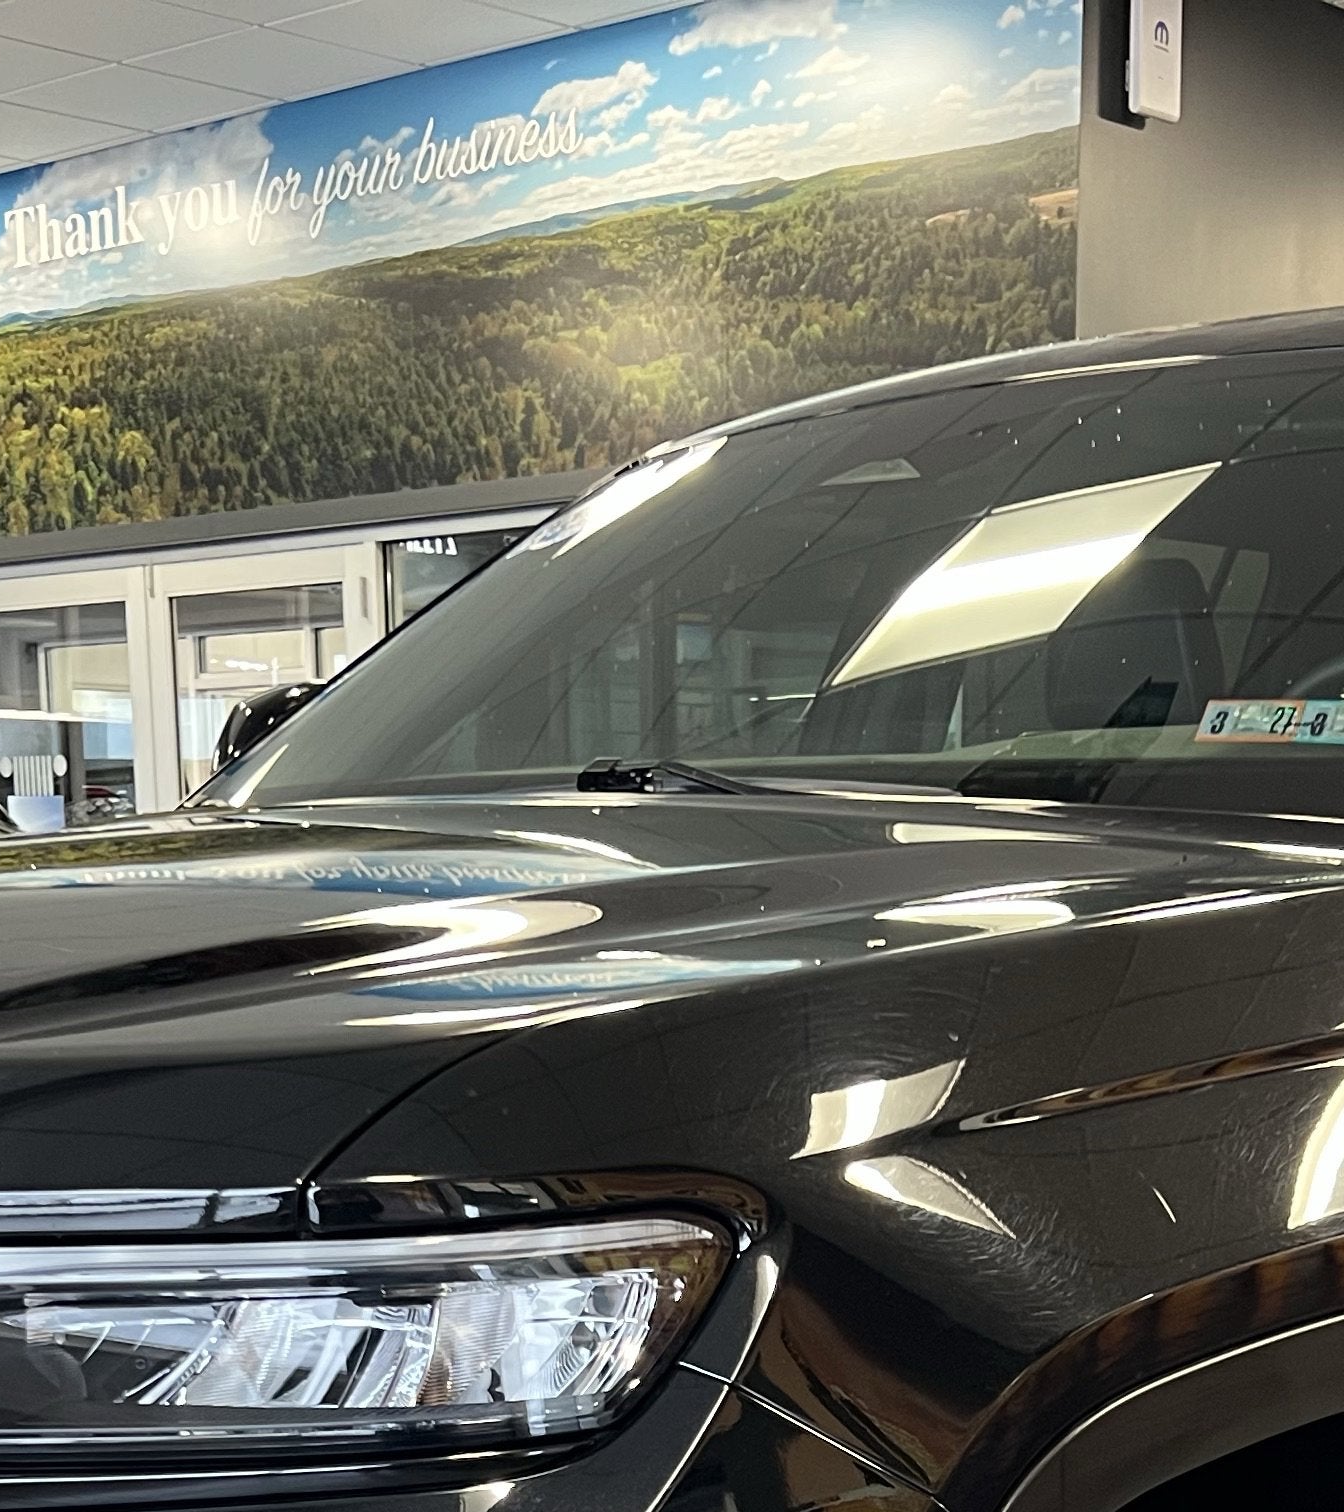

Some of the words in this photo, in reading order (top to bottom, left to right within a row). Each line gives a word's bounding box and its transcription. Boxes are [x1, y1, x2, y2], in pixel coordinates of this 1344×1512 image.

[3, 185, 144, 270] Thank
[157, 177, 241, 256] you
[247, 157, 306, 247] for
[308, 146, 405, 239] your
[413, 107, 585, 186] business
[1268, 706, 1297, 737] 27
